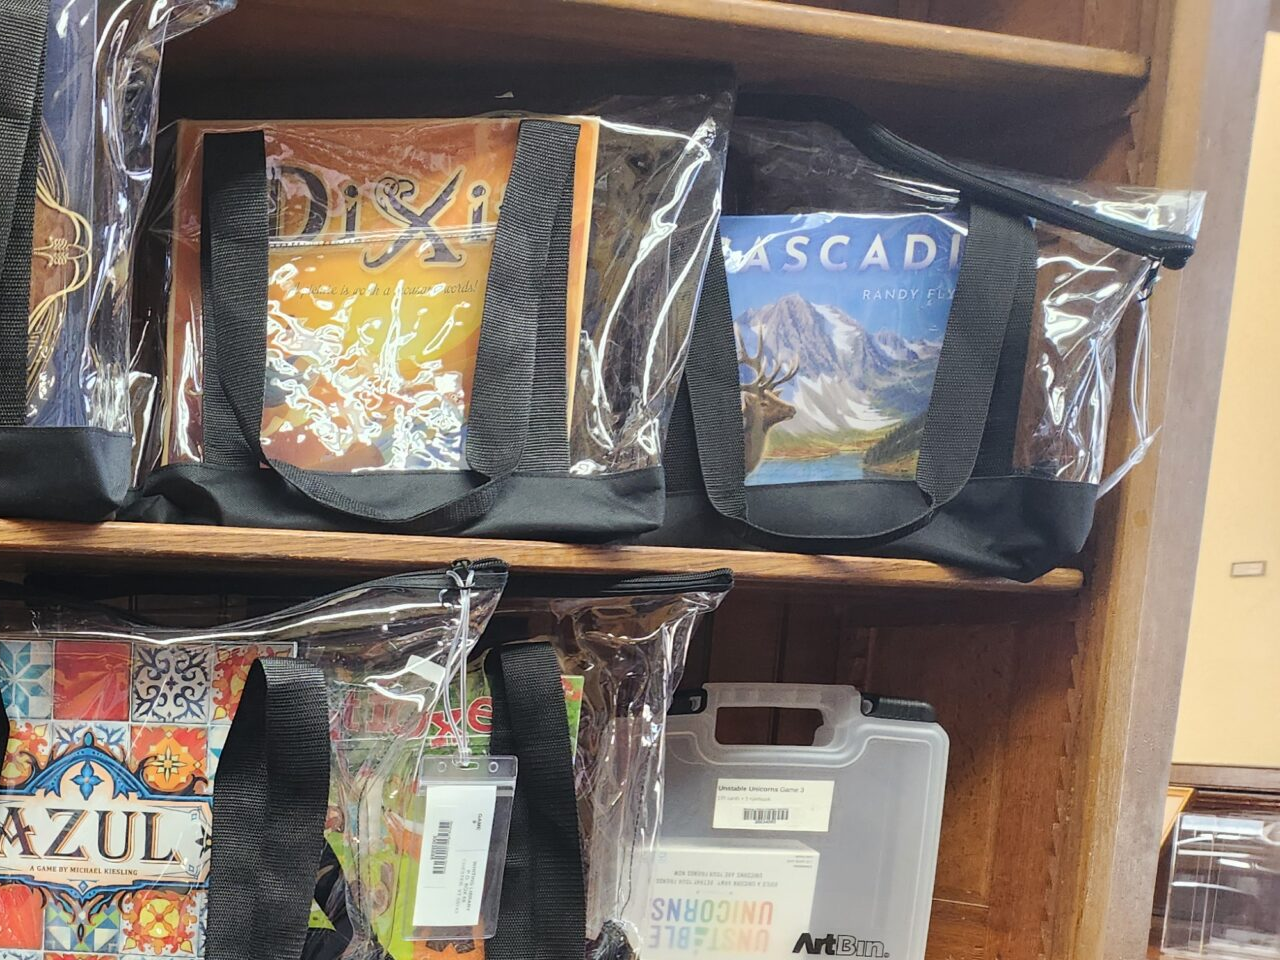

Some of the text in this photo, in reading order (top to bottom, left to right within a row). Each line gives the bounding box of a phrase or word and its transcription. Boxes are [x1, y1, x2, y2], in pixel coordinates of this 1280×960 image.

[267, 166, 507, 269] DiXi
[863, 289, 956, 301] RANDY FLY
[70, 867, 102, 875] MICHAEL
[103, 868, 138, 876] KIESLING
[651, 897, 774, 926] UNICORNS
